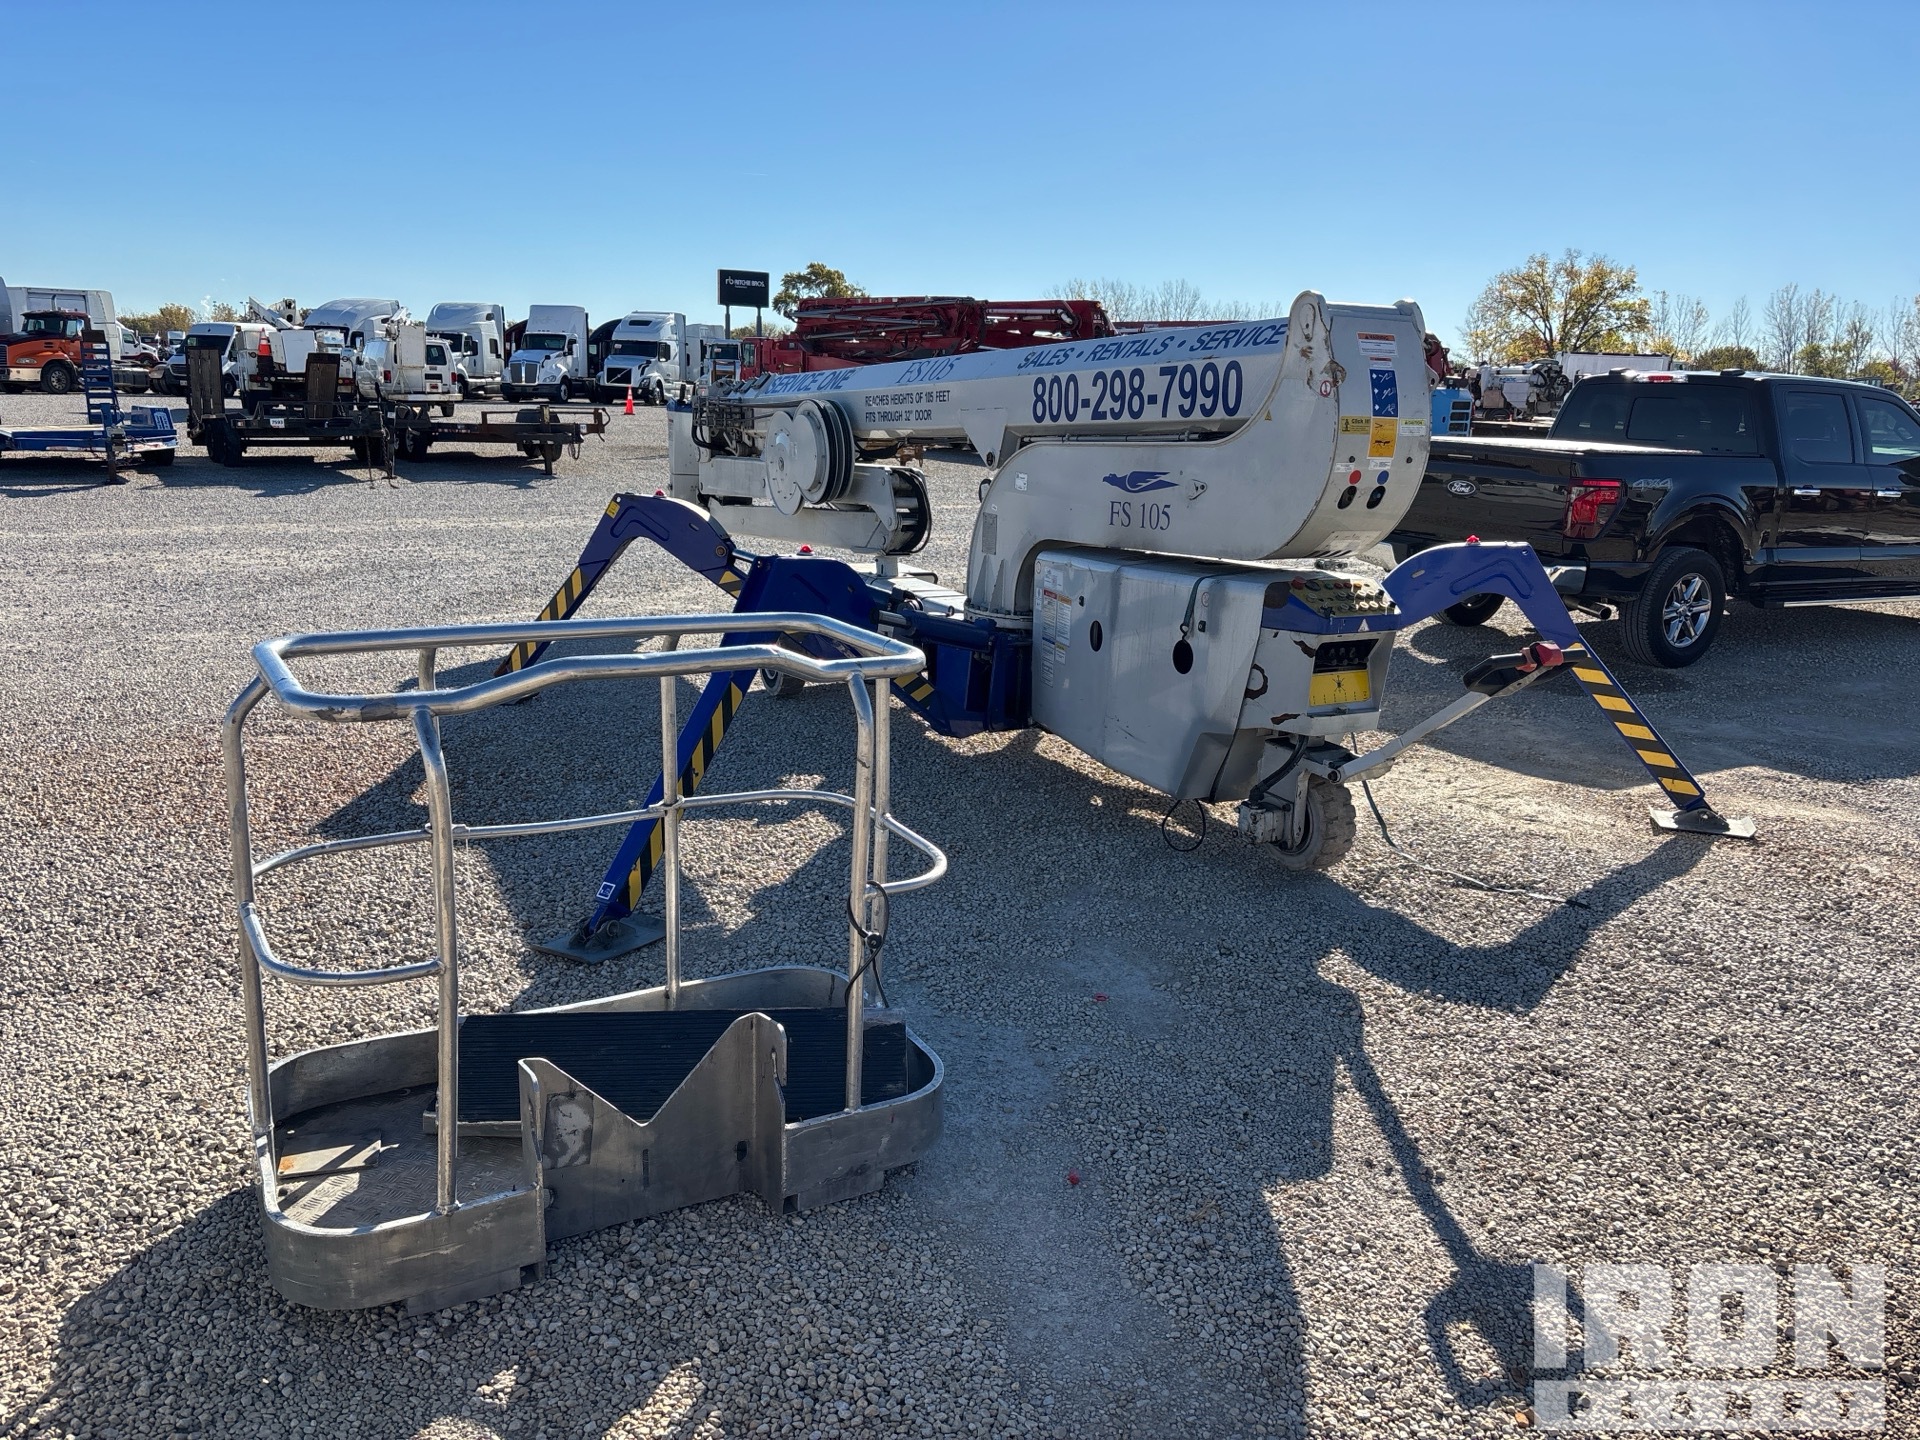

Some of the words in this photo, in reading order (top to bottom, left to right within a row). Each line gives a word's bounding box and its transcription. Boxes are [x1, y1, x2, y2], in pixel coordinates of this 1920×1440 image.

[1017, 347, 1075, 370] SALES
[1084, 335, 1175, 363] RENTALS
[1189, 323, 1289, 352] SERVICE
[764, 372, 826, 395] SERVICE
[816, 369, 857, 391] ONE
[895, 357, 963, 384] FS105
[865, 395, 890, 407] REACHES
[890, 392, 914, 405] HEIGHTS
[915, 391, 924, 404] OF
[925, 391, 934, 403] 105
[935, 390, 951, 403] FEET
[1032, 359, 1244, 424] 800-298-7990
[865, 411, 876, 423] FITS
[877, 410, 903, 422] THROUGH
[915, 409, 933, 421] DOOR
[1450, 482, 1472, 493] Ford
[1108, 500, 1132, 528] FS
[1139, 502, 1171, 531] 105
